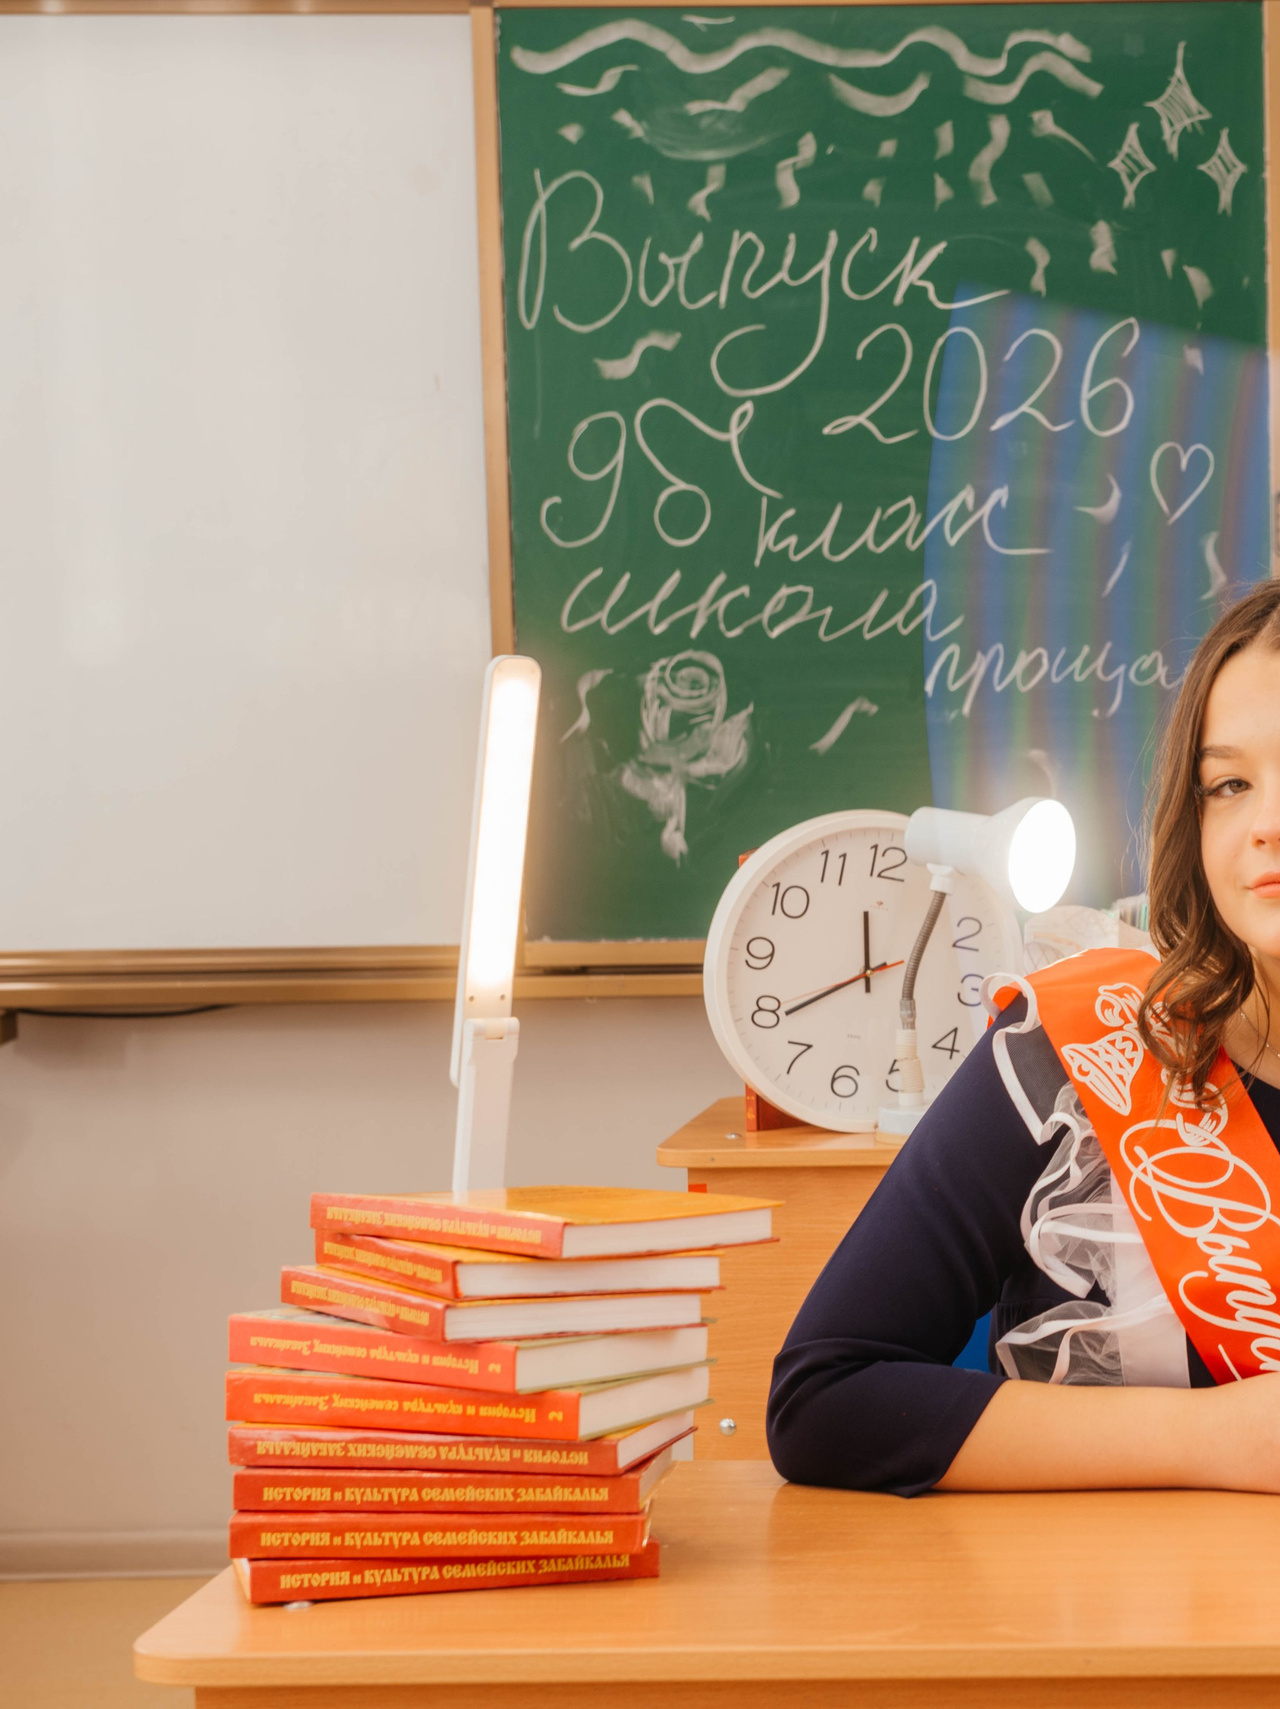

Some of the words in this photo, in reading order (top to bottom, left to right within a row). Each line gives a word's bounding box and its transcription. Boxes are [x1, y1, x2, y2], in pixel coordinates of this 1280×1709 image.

[518, 168, 1010, 397] Выпуск
[822, 317, 1141, 445] 2026
[756, 484, 1053, 568] класс
[560, 567, 963, 643] школа
[924, 641, 1184, 718] проща
[820, 850, 848, 886] 11
[870, 844, 908, 882] 12
[771, 882, 810, 919] 10
[952, 917, 982, 952] 2
[745, 936, 775, 970] 9
[957, 973, 984, 1007] 3
[751, 995, 781, 1029] 8
[787, 1040, 814, 1075] 7
[931, 1027, 960, 1060] 4
[831, 1065, 860, 1098] 6
[256, 1440, 346, 1458] ЗАБАЙКАЛЬЯ
[347, 1442, 438, 1461] СЕМЕЙСКИХ
[439, 1444, 511, 1462] КУЛЬТУРА
[523, 1448, 589, 1466] ИСТОРИЯ
[263, 1486, 332, 1502] ИСТОРИЯ
[344, 1486, 420, 1505] КУЛЬТУРА
[421, 1485, 515, 1502] СЕМЕЙСКИХ
[515, 1485, 609, 1503] ЗАБАЙКАЛЬЯ
[260, 1531, 331, 1547] ИСТОРИЯ
[344, 1530, 421, 1550] КУЛЬТУРА
[423, 1528, 518, 1546] СЕМЕЙСКИХ
[519, 1528, 614, 1547] ЗАБАЙКАЛЬЯ
[279, 1570, 350, 1590] ИСТОРИЯ
[363, 1564, 440, 1587] КУЛЬТУРА
[442, 1558, 536, 1579] СЕМЕЙСКИХ
[537, 1553, 631, 1575] ЗАБАЙКАЛЬЯ
